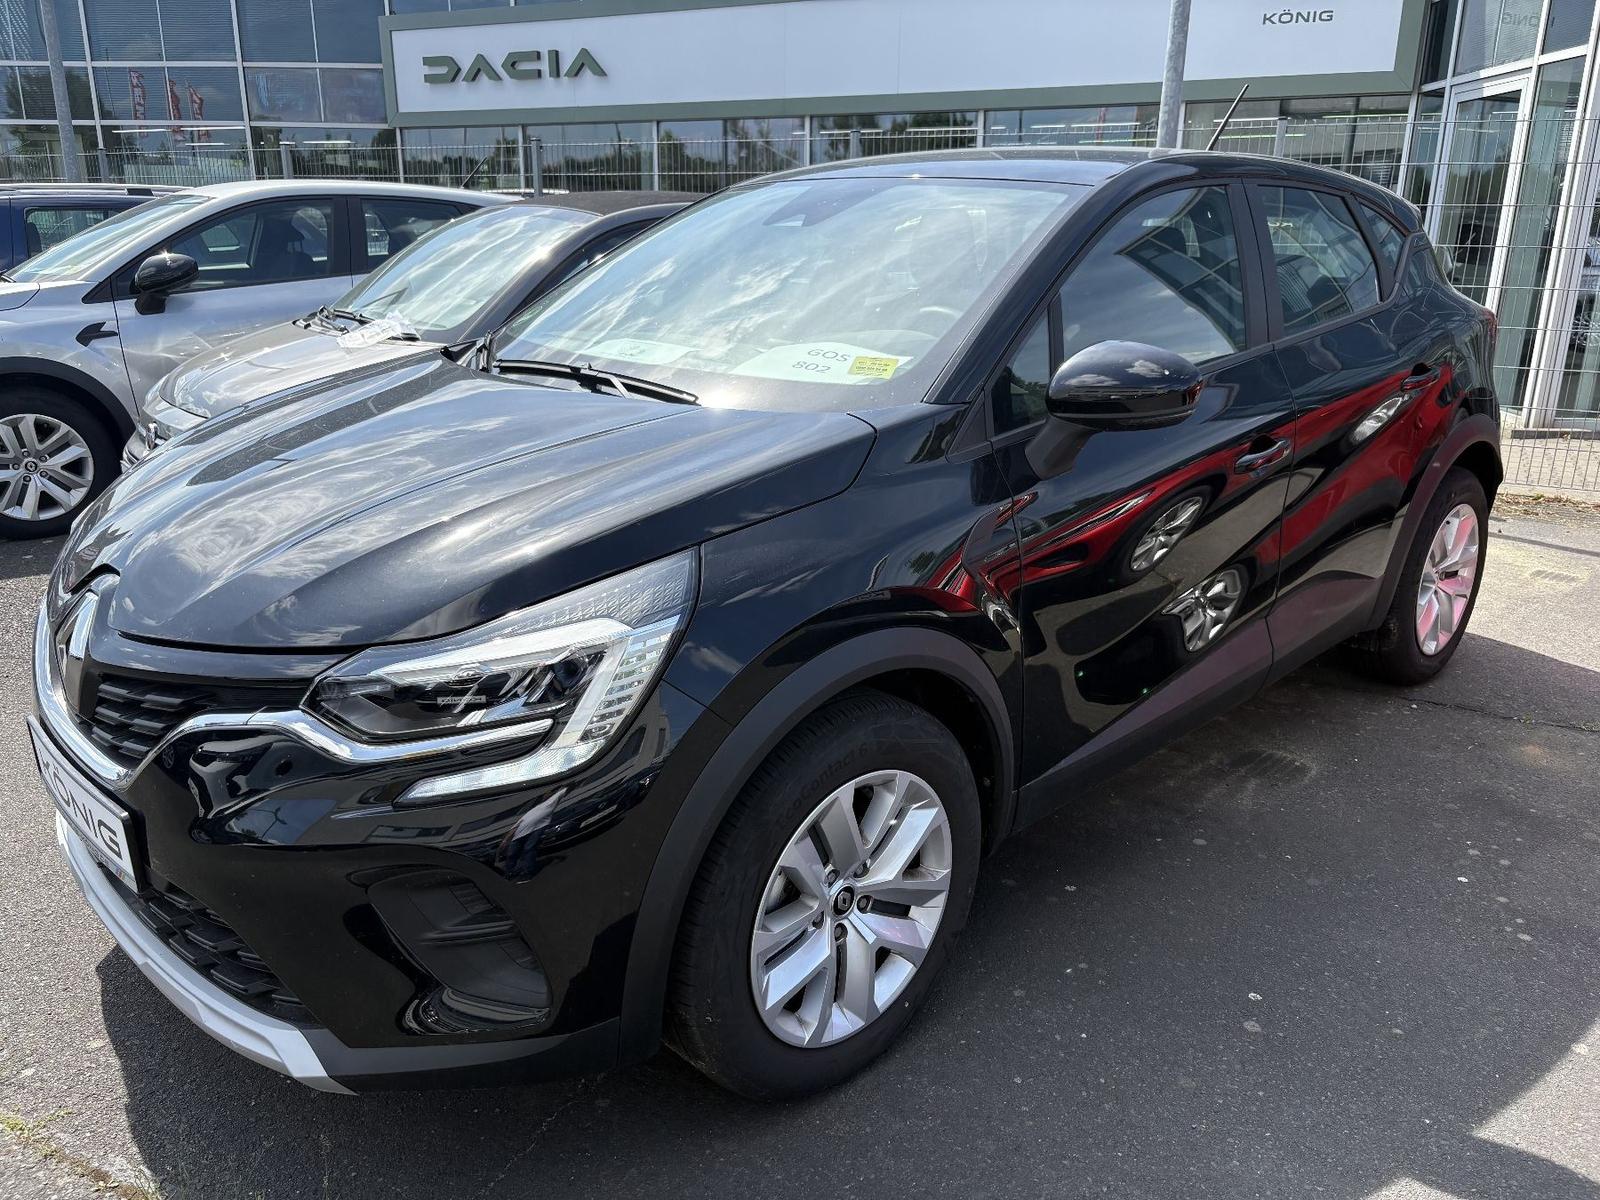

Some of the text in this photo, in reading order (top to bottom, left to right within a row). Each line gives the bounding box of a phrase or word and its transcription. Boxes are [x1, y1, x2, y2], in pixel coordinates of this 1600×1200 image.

[1262, 9, 1334, 25] KÖNIG
[422, 47, 608, 84] DACIA
[792, 360, 831, 373] 802
[38, 747, 123, 861] KÖNIG
